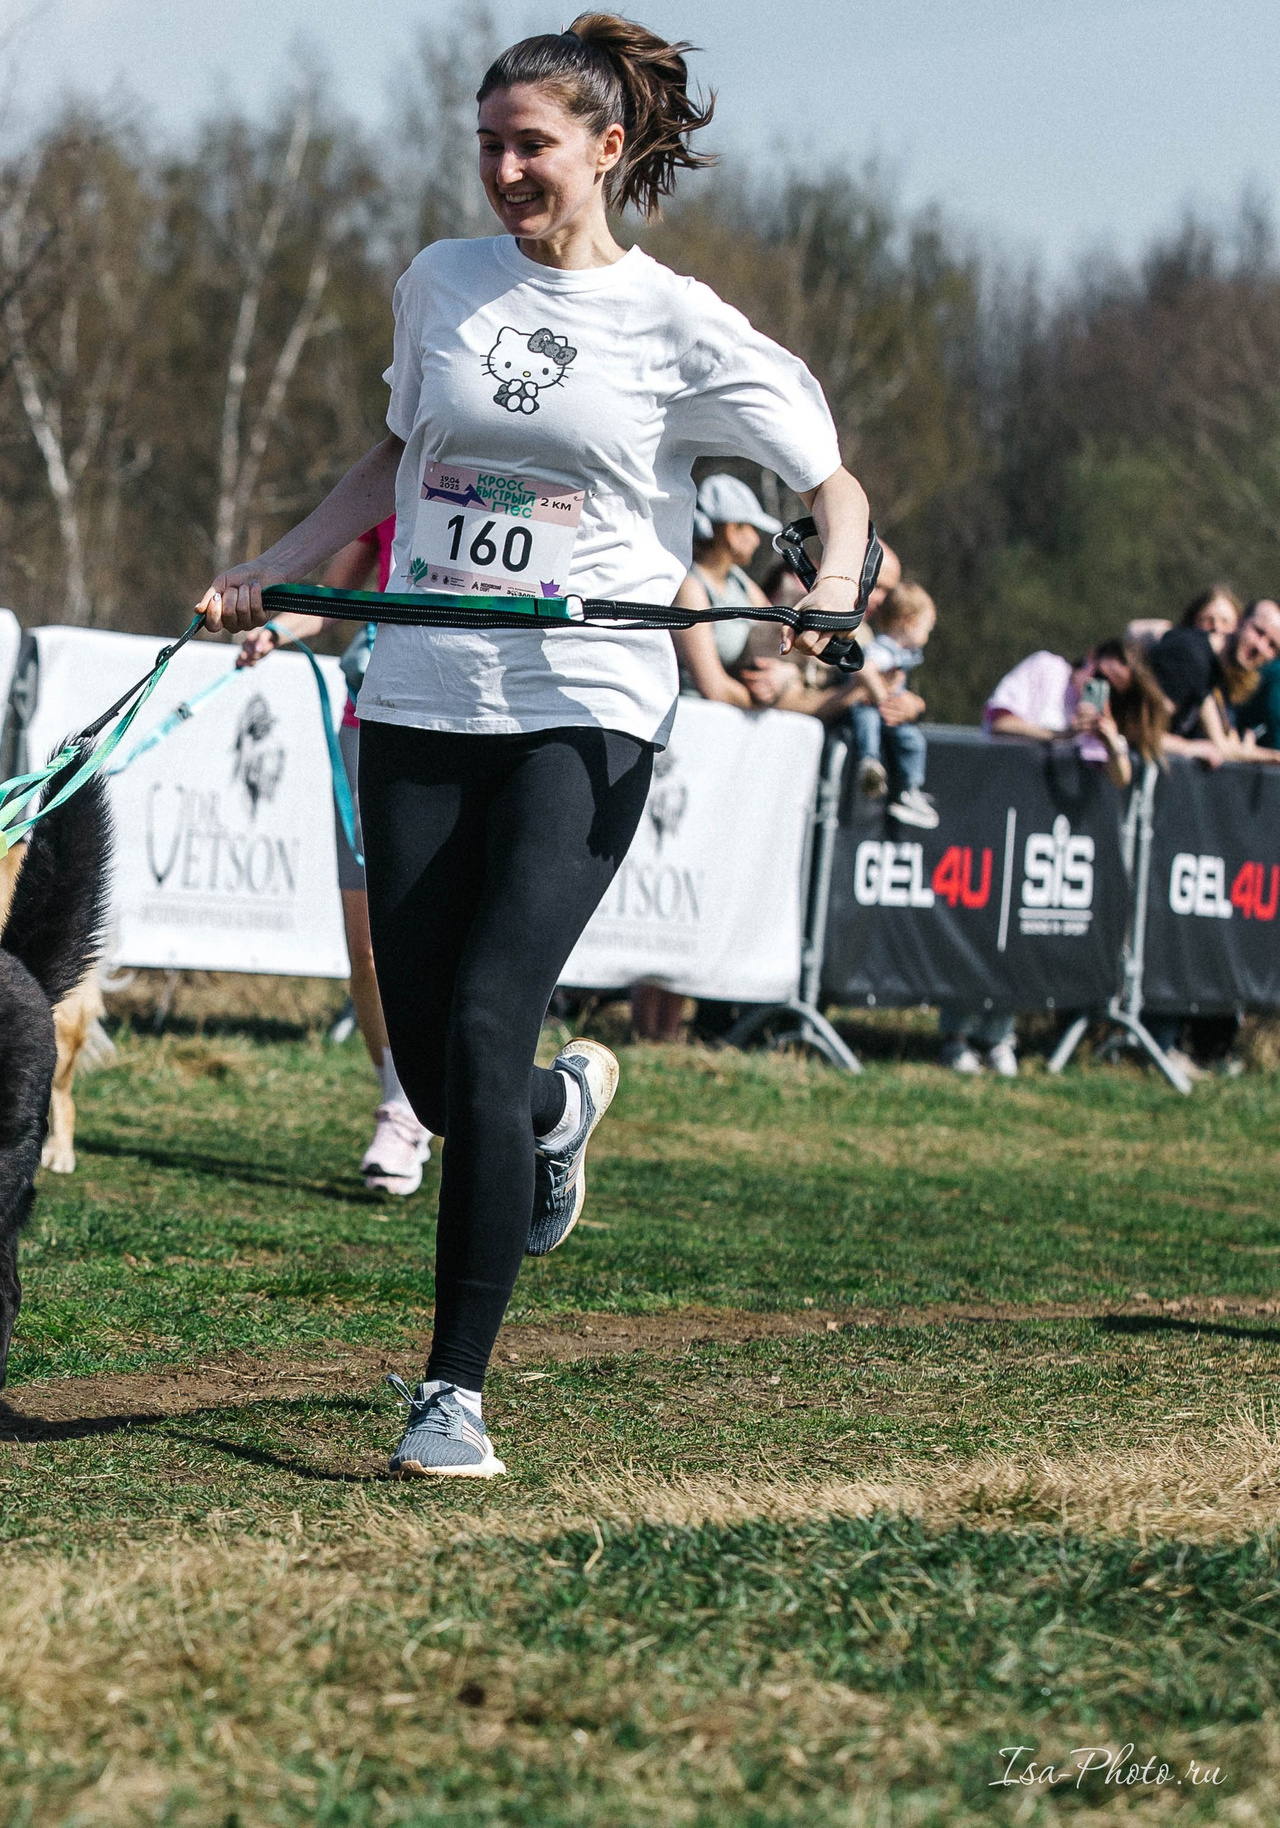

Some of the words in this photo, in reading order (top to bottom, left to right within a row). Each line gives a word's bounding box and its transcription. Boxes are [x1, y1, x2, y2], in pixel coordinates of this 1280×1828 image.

[439, 475, 460, 485] 19.04
[439, 481, 460, 491] 2025
[477, 473, 525, 493] КРОСС
[476, 486, 537, 507] БЫСТРЫЙ
[540, 497, 550, 507] 2
[447, 514, 533, 573] 160
[854, 840, 993, 909] GEL4U
[1169, 852, 1280, 922] GEL4U
